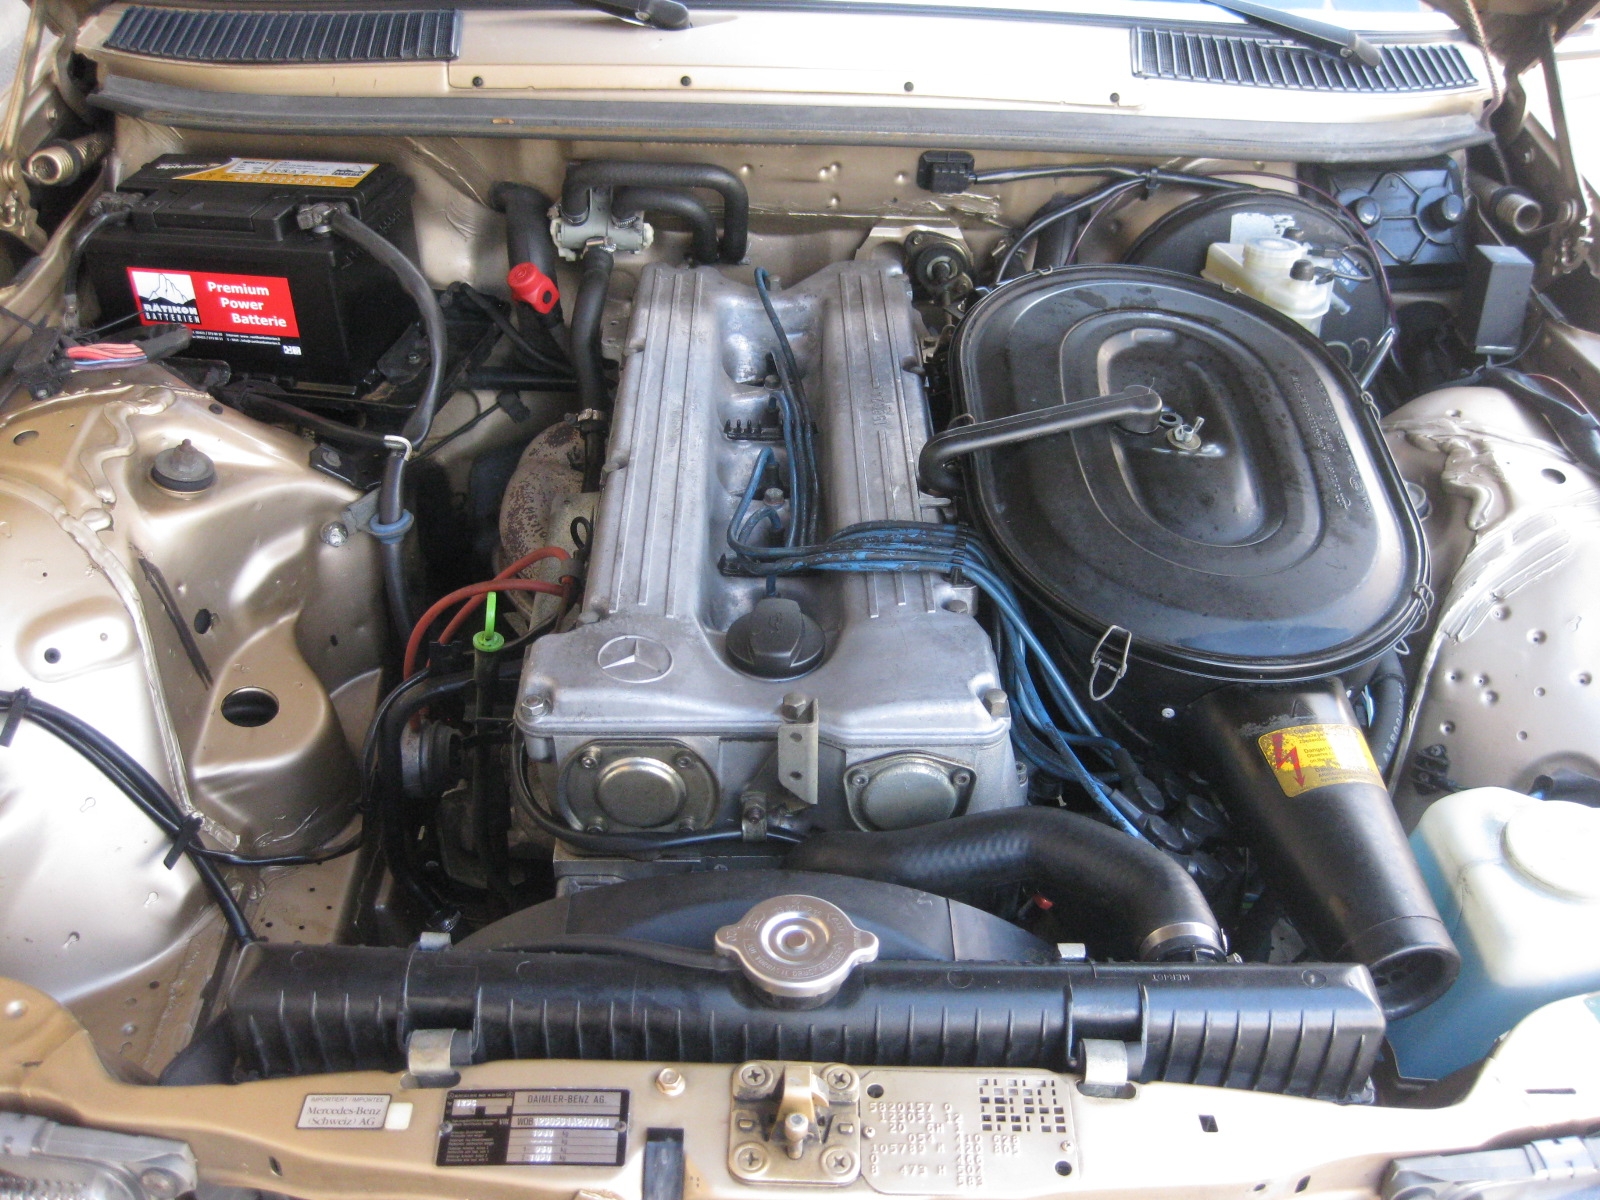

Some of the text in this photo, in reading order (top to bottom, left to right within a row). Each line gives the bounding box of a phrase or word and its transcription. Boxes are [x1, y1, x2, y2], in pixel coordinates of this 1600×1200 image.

[206, 281, 270, 297] Premium
[219, 297, 264, 312] Power
[145, 312, 201, 324] BATTERIEN
[231, 312, 287, 328] Batterie
[527, 1094, 589, 1104] DAIMLER-BENZ
[306, 1106, 382, 1115] Mercedes-Benz
[868, 1102, 934, 1113] 5820157
[308, 1117, 376, 1126] (Schweiz) AG
